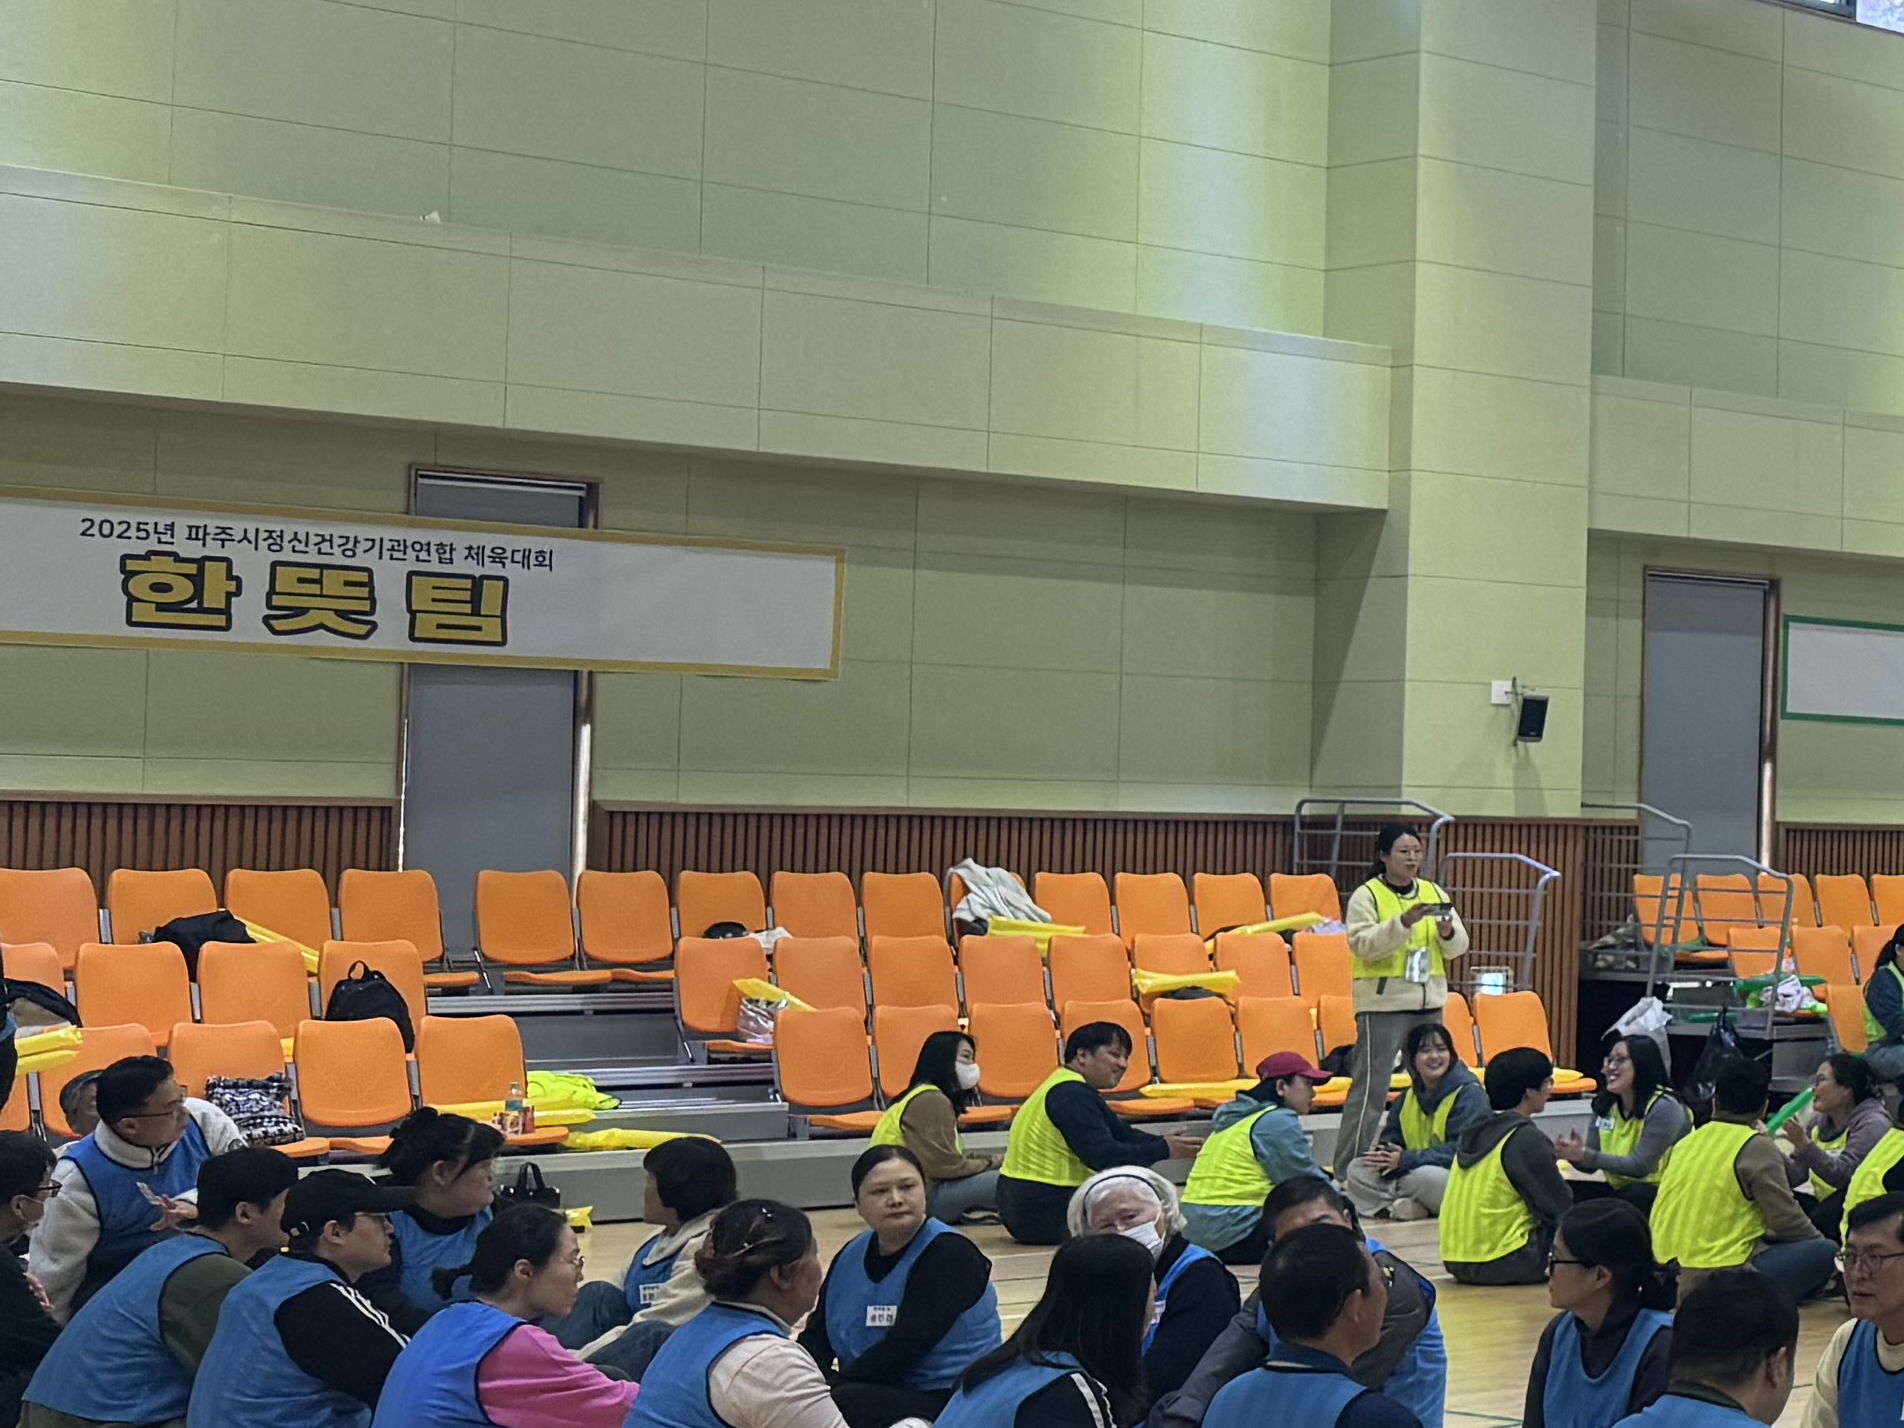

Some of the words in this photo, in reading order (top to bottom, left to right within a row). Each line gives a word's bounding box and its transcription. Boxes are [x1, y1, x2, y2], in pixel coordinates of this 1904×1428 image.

[79, 516, 176, 548] 2025년
[184, 522, 458, 567] 파주시정신건강기관연합
[463, 542, 555, 573] 체육대회
[119, 550, 510, 647] 한뜻팀
